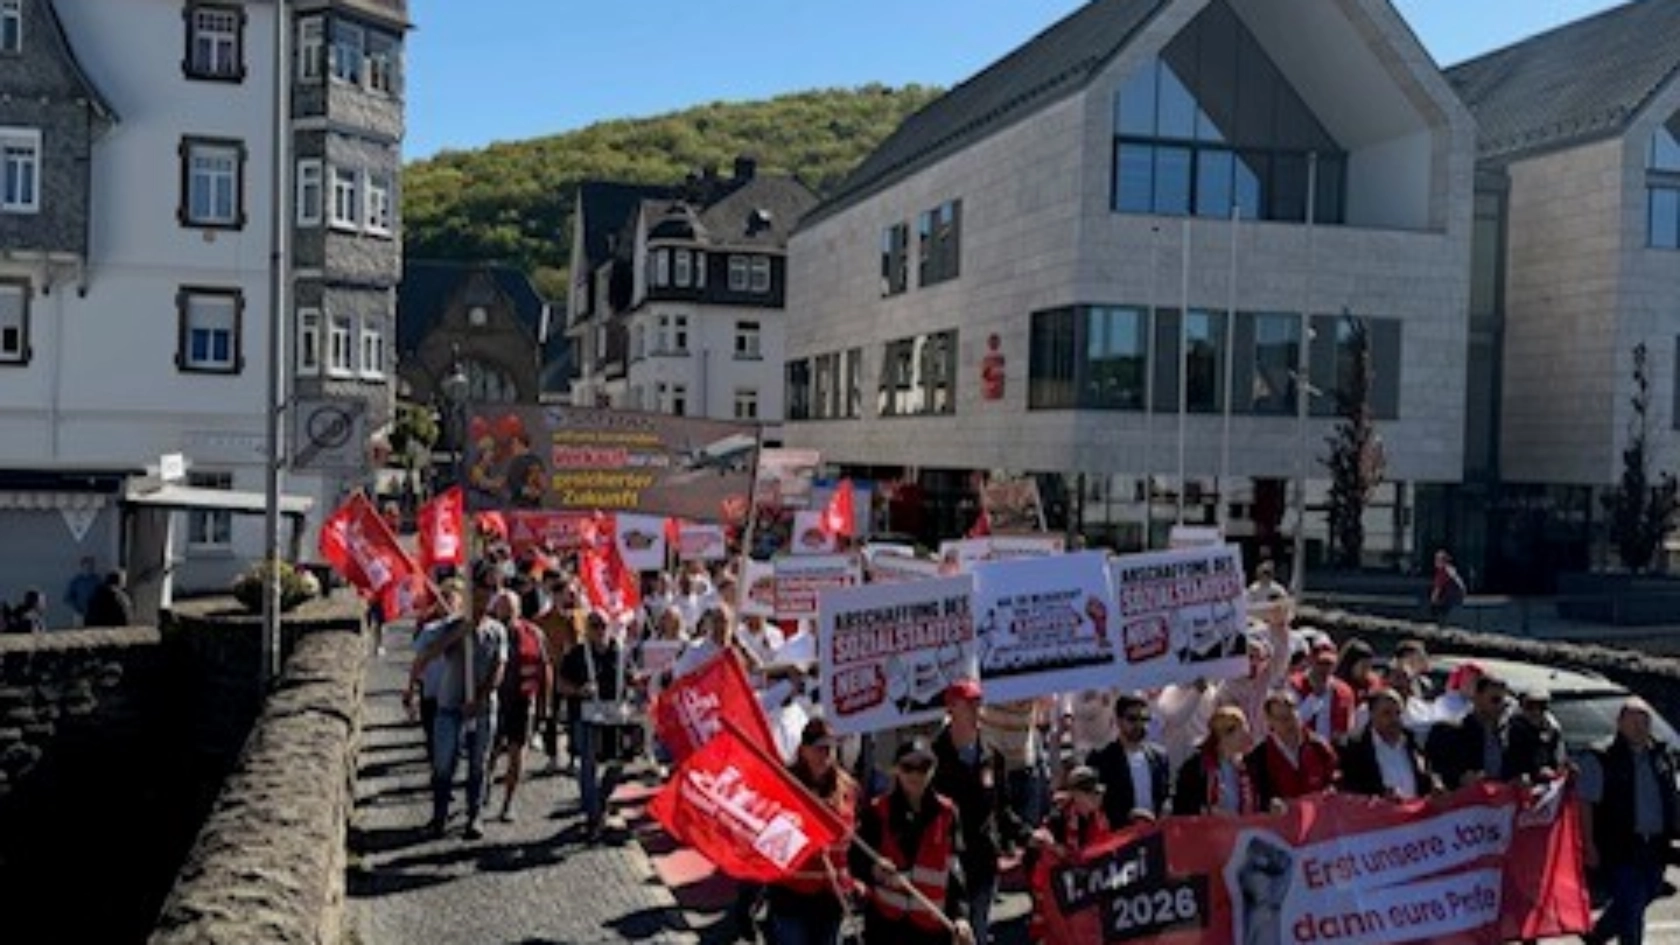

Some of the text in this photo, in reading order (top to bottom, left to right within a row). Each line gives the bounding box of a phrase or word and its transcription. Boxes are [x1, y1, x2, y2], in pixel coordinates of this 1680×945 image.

[563, 490, 638, 506] Zukunft
[1302, 850, 1362, 890] Erst
[1364, 835, 1446, 873] unsere
[1112, 887, 1197, 930] 2026
[1292, 908, 1384, 943] dann
[1389, 901, 1447, 927] eure
